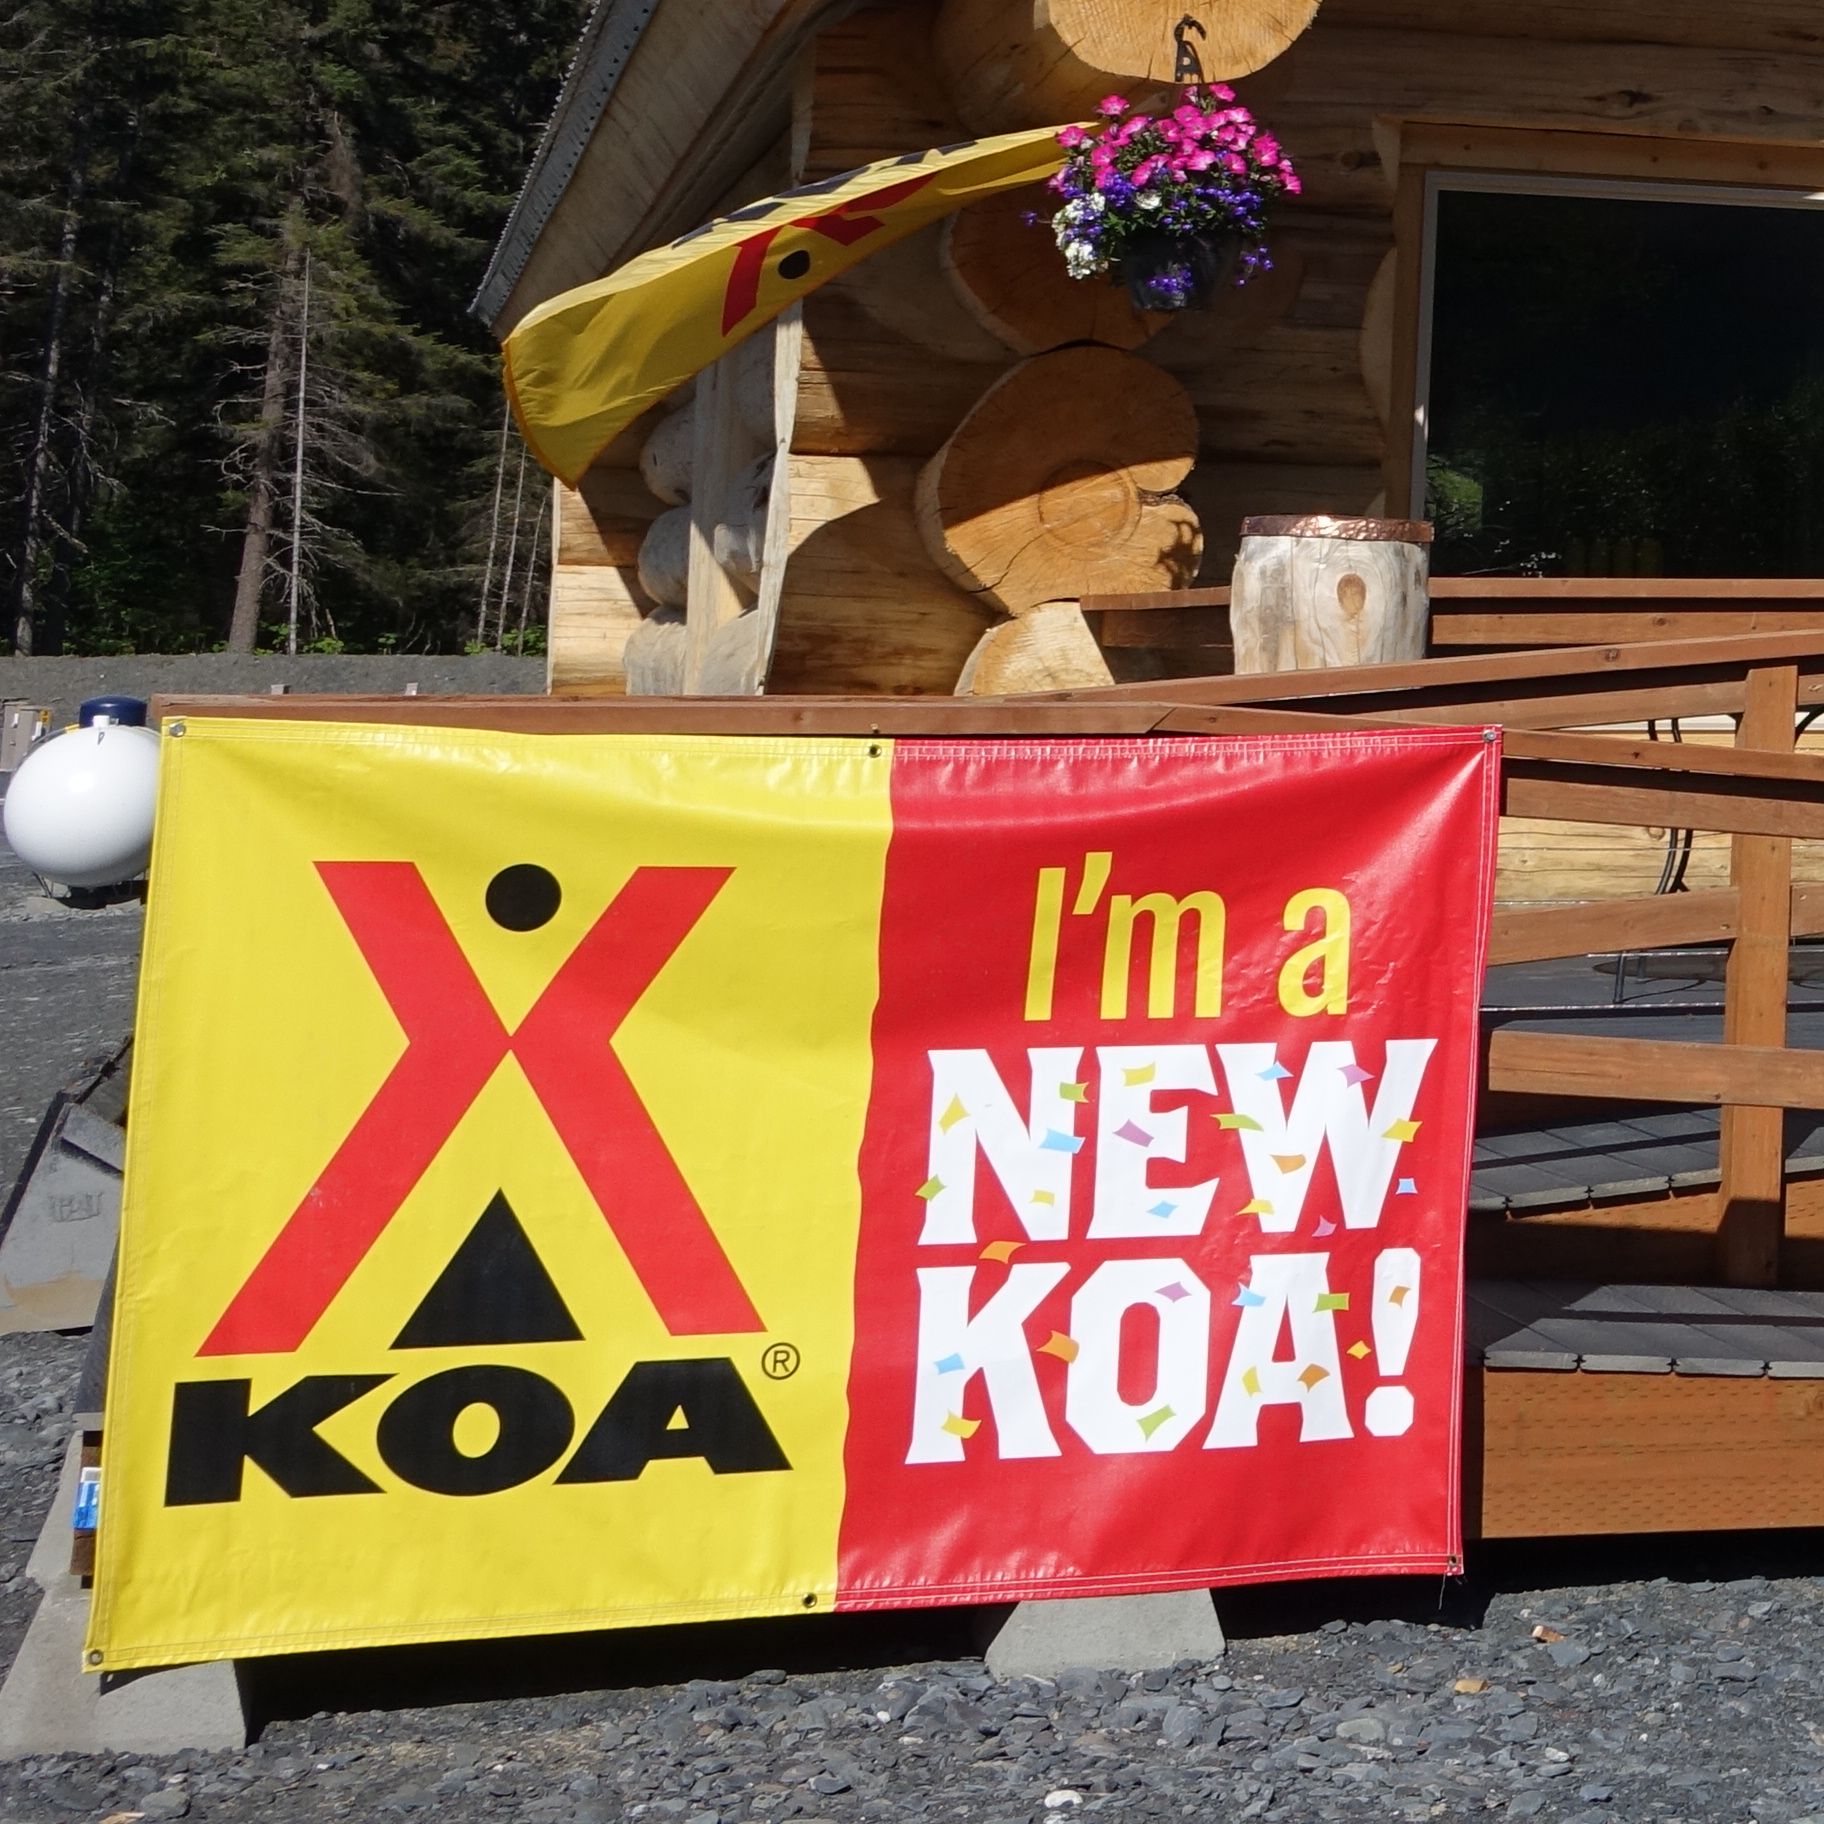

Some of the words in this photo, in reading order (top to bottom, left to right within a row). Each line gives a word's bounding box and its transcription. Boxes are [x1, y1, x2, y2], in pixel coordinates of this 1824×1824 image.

[1023, 851, 1227, 1021] I'm
[1280, 885, 1351, 1017] a
[917, 1038, 1440, 1247] NEW
[164, 1357, 794, 1507] KOA
[903, 1247, 1423, 1465] KOA!
